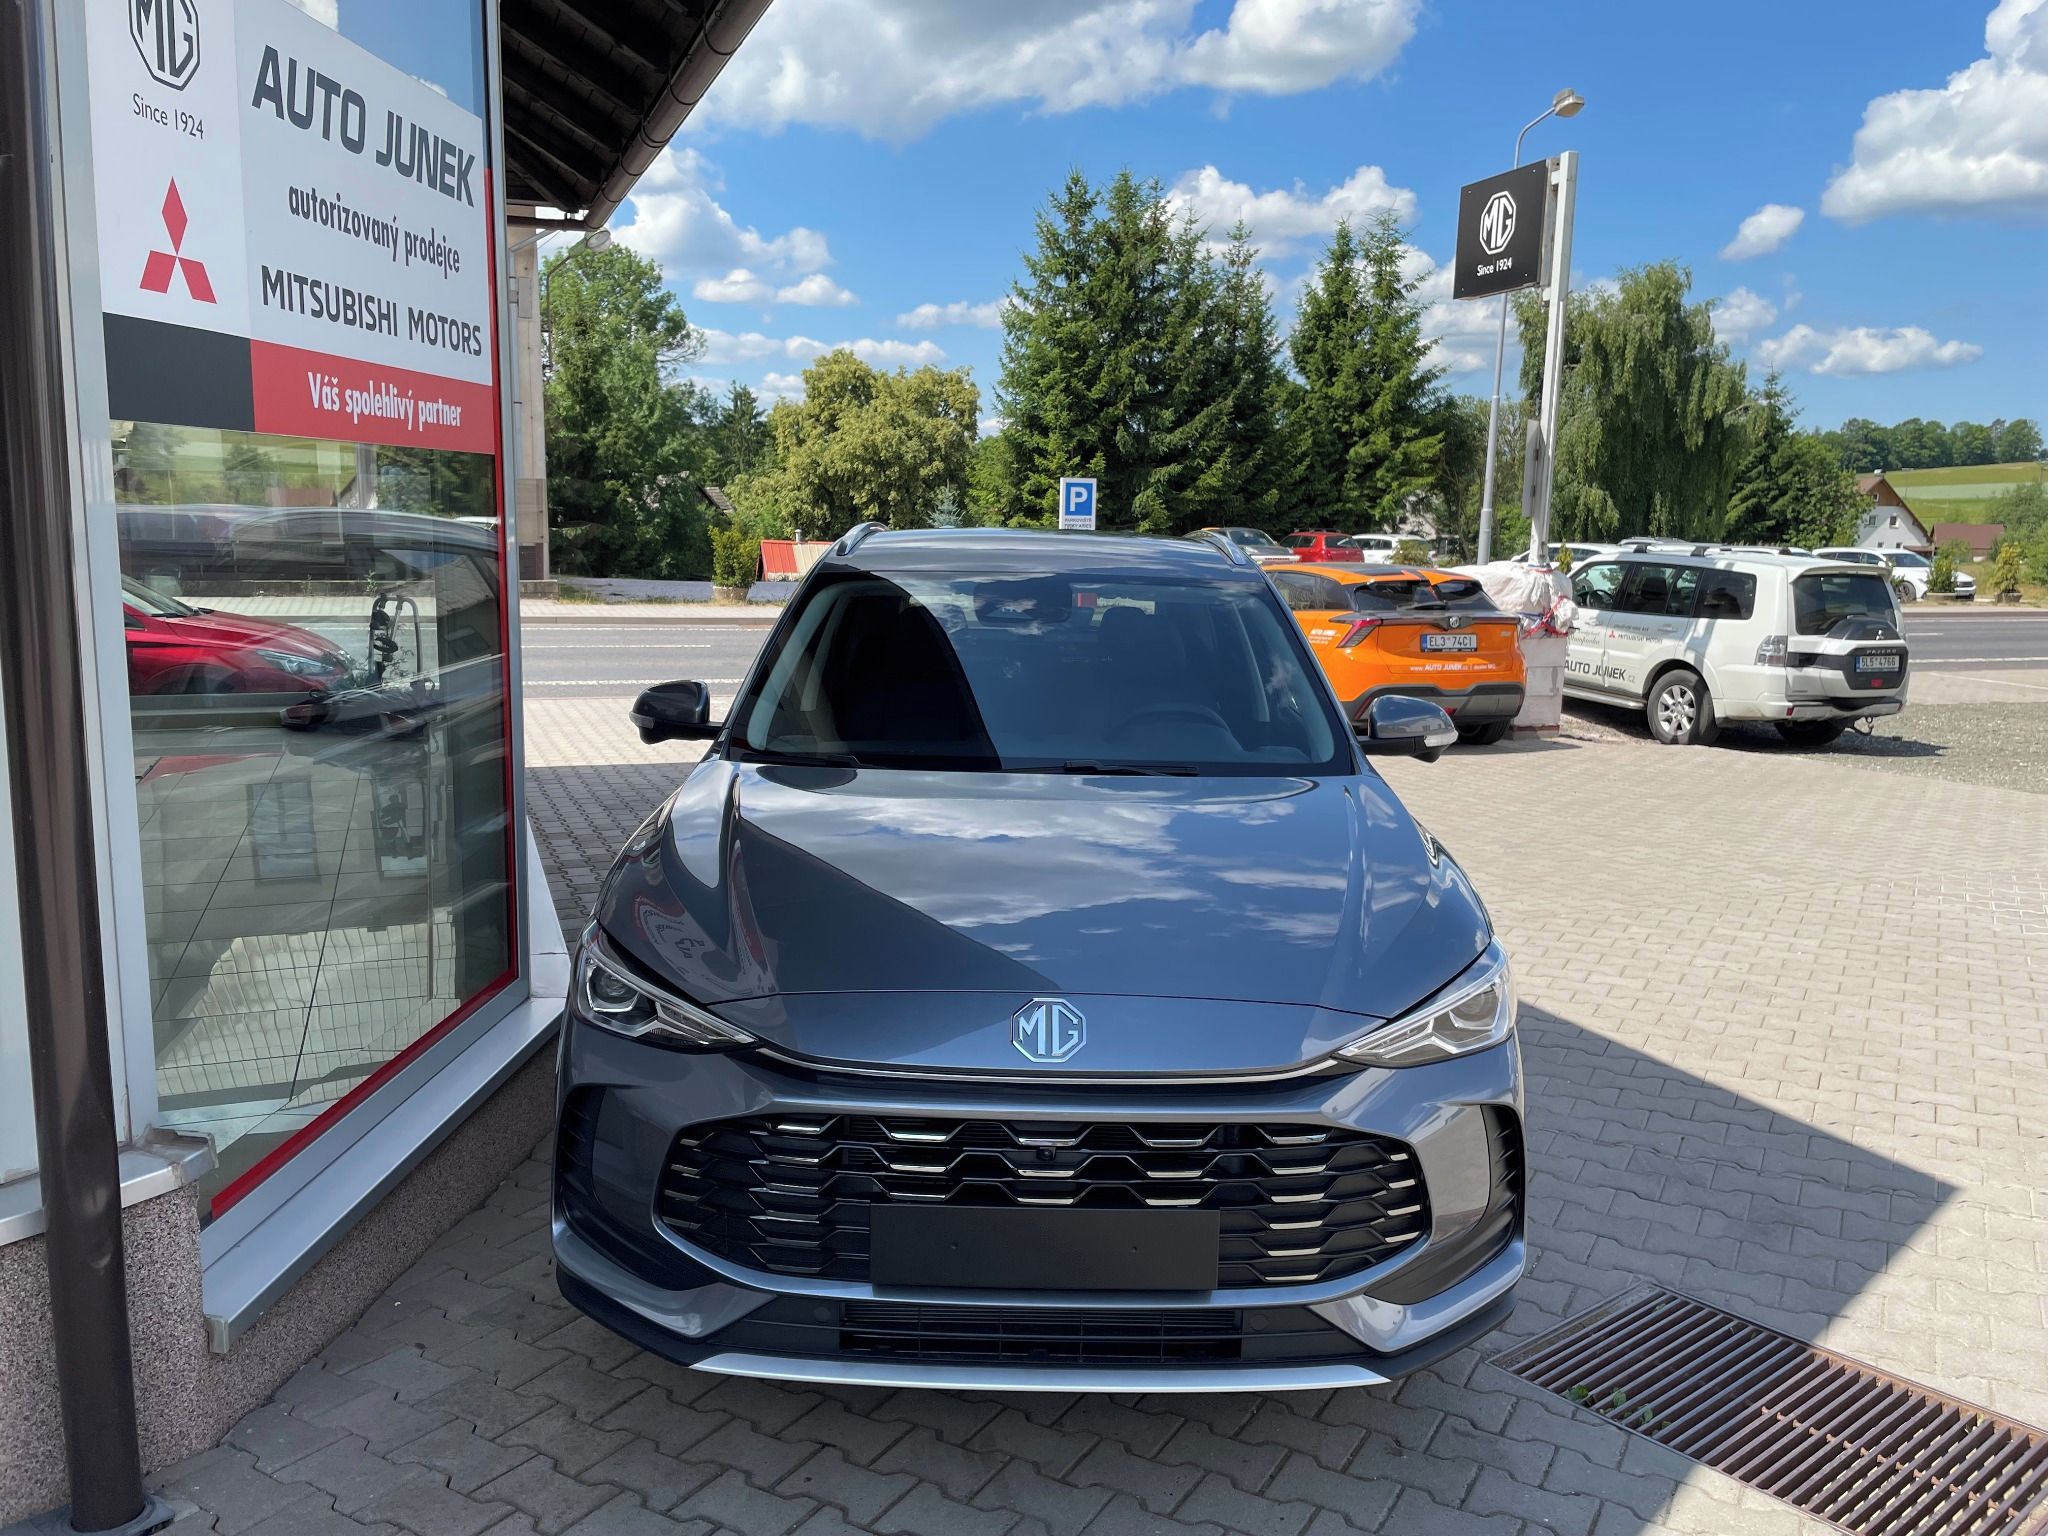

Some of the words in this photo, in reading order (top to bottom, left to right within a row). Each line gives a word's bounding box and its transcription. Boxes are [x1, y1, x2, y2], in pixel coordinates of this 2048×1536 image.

[135, 0, 194, 78] MG
[133, 93, 168, 126] Since
[174, 108, 204, 140] 1924
[251, 44, 367, 155] AUTO
[375, 109, 476, 208] JUNEK
[288, 185, 399, 262] autorizovaný
[404, 227, 460, 280] prodejce
[1482, 196, 1513, 249] MG
[1476, 264, 1494, 277] Since
[1496, 256, 1512, 272] 1924
[261, 264, 398, 337] MITSUBISHI
[407, 306, 482, 357] MOTORS
[307, 371, 340, 412] Váš
[345, 380, 414, 431] spolehlivý
[418, 398, 462, 432] partner
[1069, 486, 1088, 512] P
[1429, 636, 1446, 647] EL3
[1563, 660, 1590, 674] AUTO
[1018, 1004, 1079, 1056] MG
